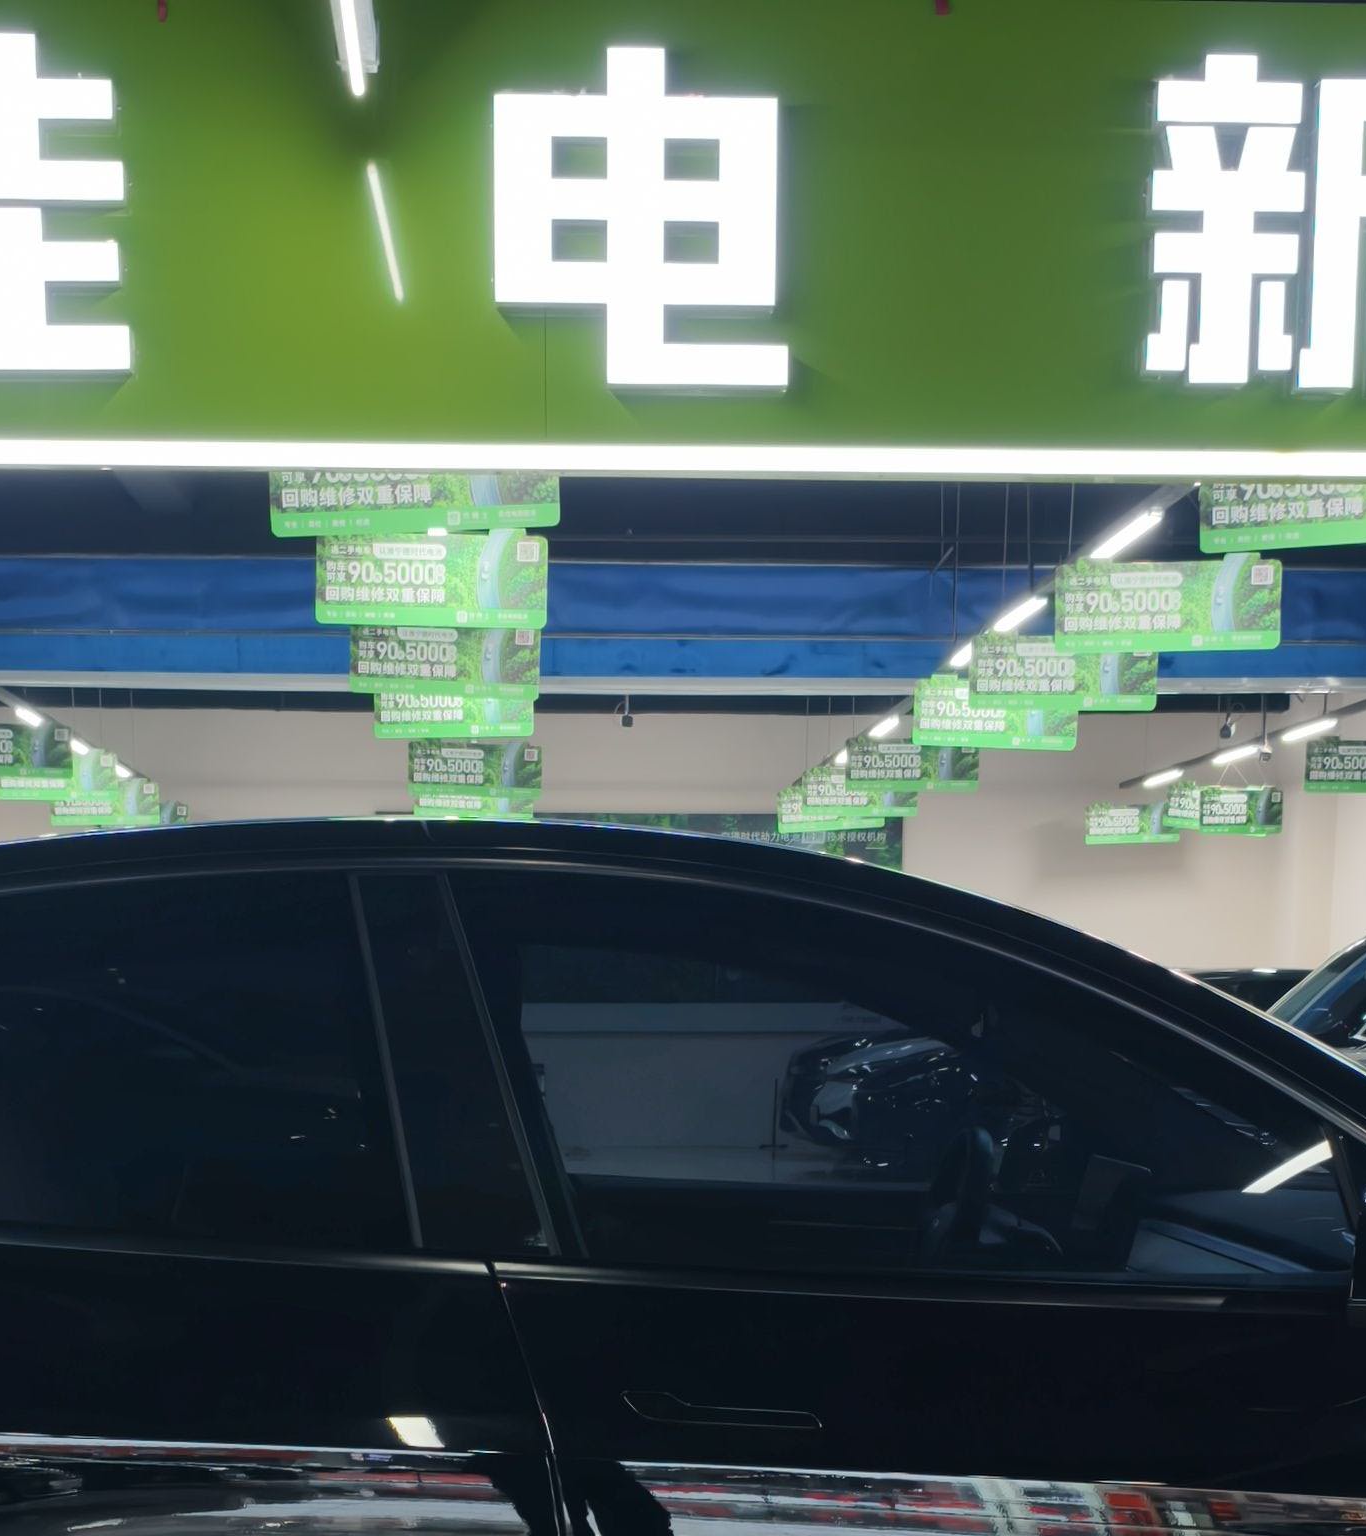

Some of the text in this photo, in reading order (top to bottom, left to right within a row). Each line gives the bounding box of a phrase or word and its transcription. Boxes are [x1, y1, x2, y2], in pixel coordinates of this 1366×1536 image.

[282, 484, 432, 509] 回购维修双重保障
[1211, 497, 1364, 525] 回购维修双重保障
[325, 586, 446, 603] 回购维修双重保障
[1064, 614, 1181, 632] 回购维修双重保障
